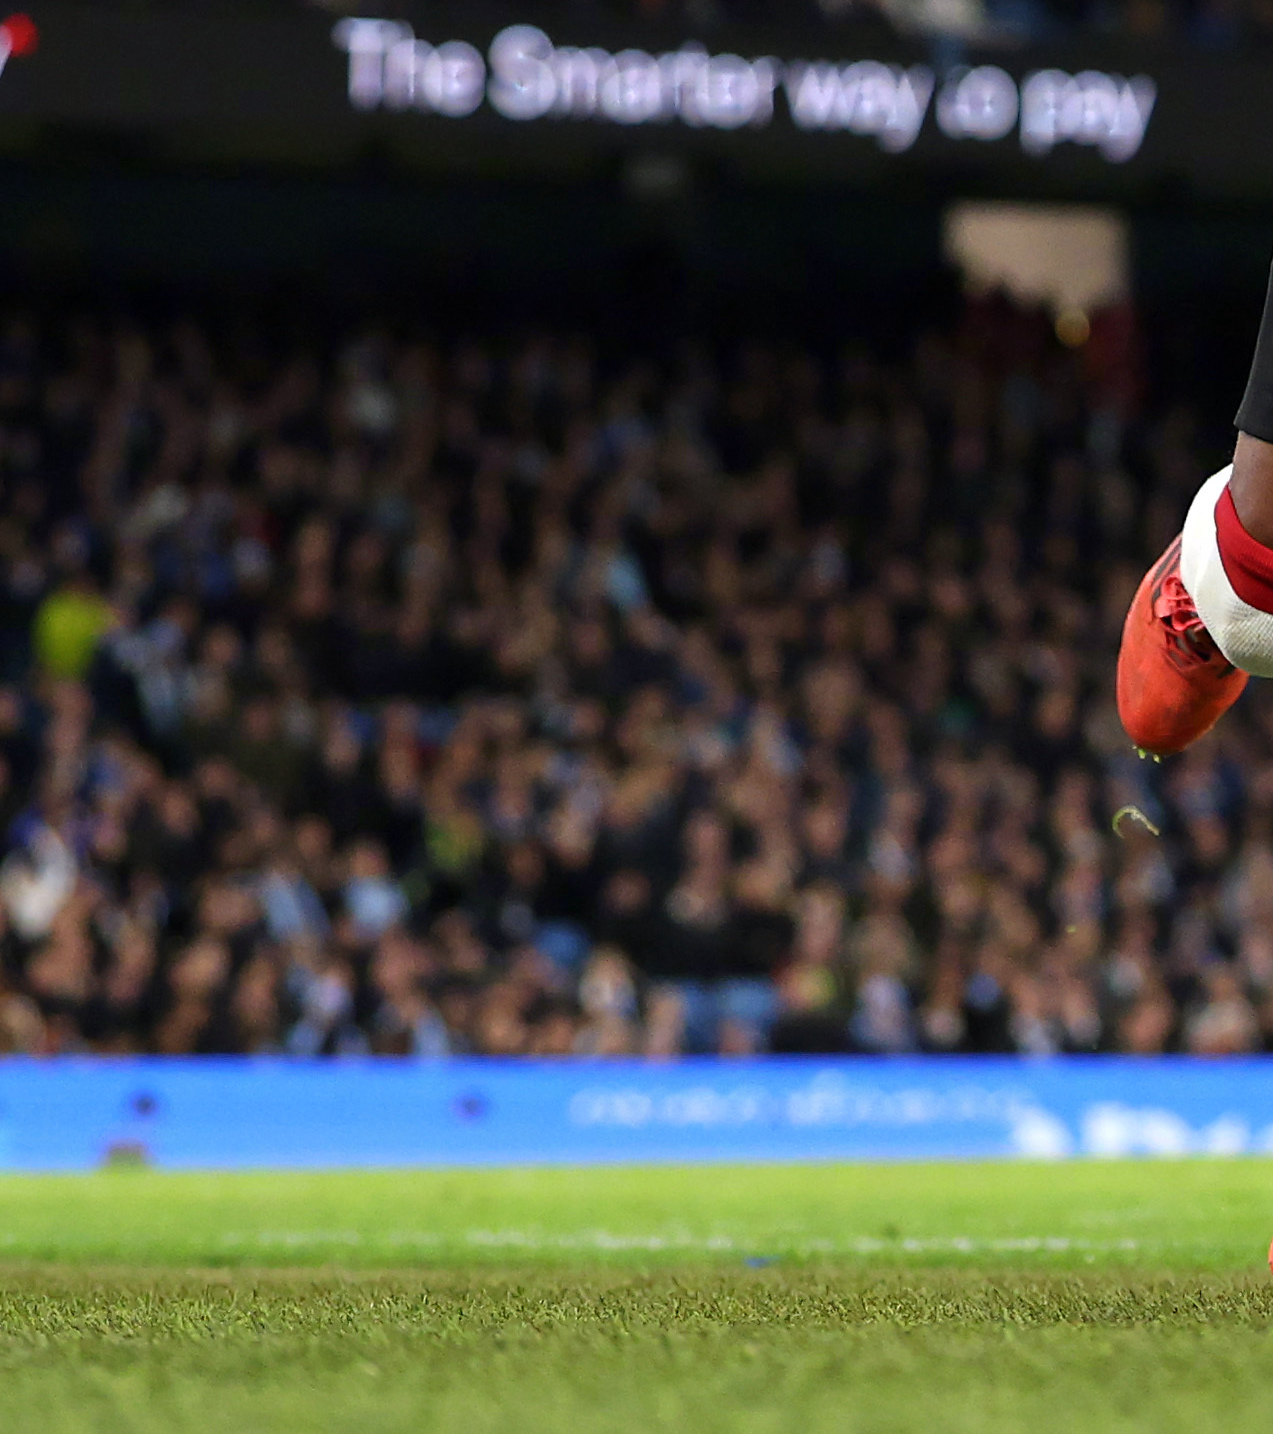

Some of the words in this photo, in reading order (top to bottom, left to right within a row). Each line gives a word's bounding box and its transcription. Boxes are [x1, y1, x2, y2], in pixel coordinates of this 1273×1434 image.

[331, 17, 486, 118] The
[487, 23, 783, 131] Smarter
[781, 58, 936, 154] way
[1019, 68, 1157, 164] pay
